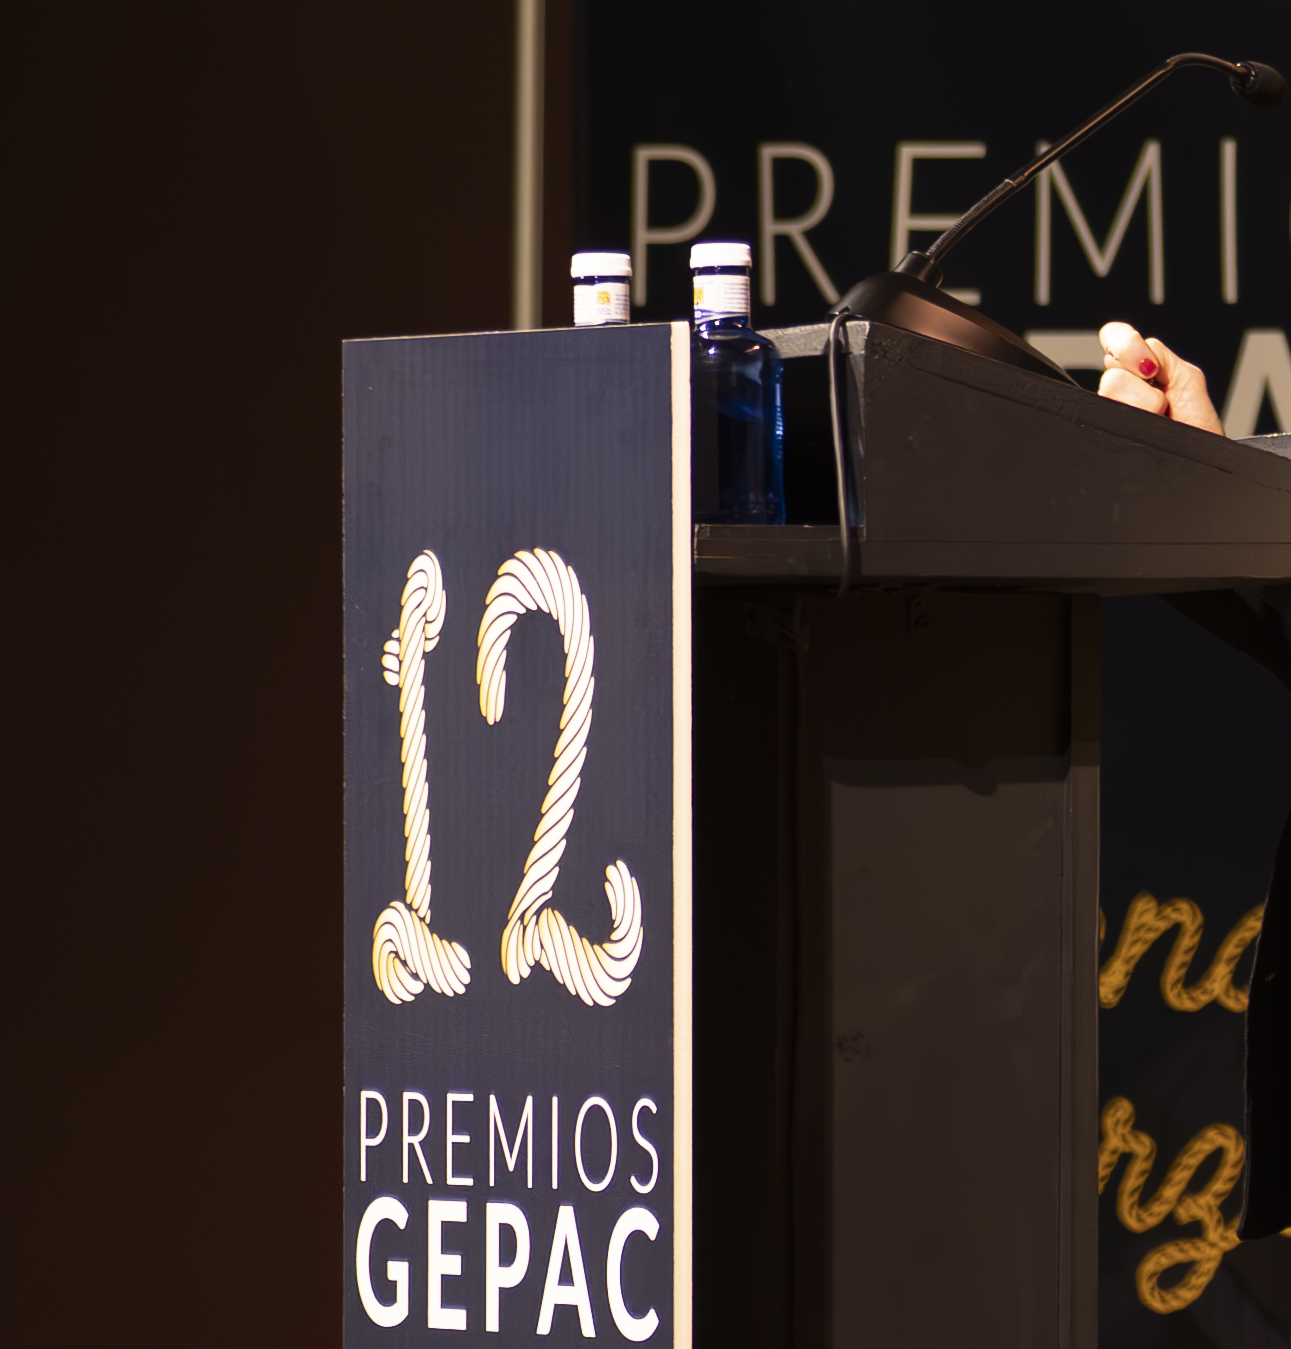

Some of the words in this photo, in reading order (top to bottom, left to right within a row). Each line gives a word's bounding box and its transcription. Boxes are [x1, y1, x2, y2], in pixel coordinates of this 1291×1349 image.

[372, 546, 646, 1008] 12
[359, 1090, 660, 1194] PREMIOS
[355, 1196, 661, 1342] GEPAC
